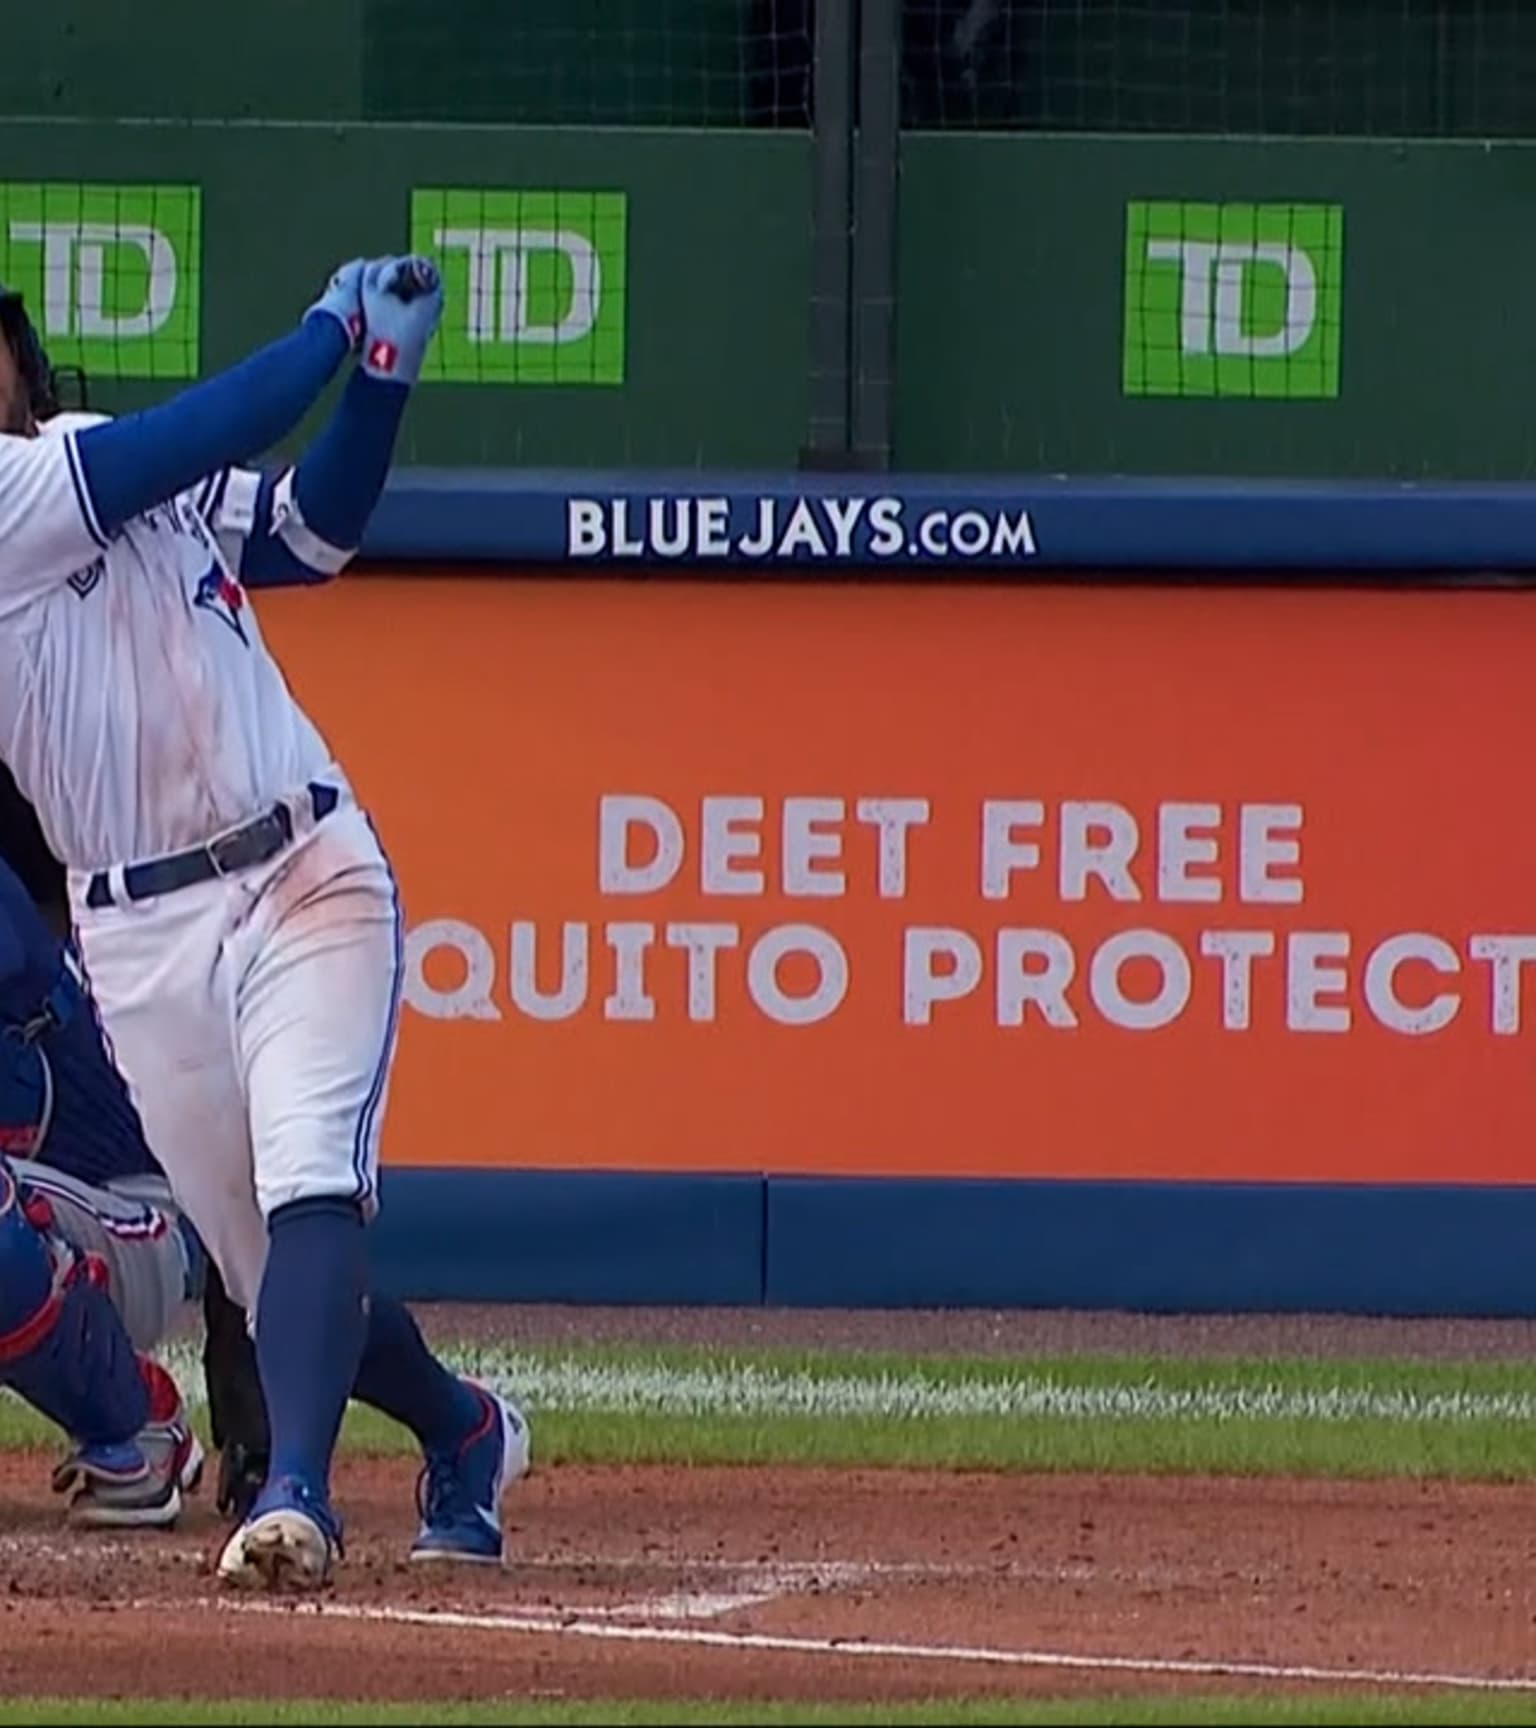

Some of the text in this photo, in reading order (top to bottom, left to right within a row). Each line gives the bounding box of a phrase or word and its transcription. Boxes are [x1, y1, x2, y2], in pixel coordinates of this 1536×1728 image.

[9, 221, 177, 338] TD
[433, 228, 602, 344] TD
[1147, 240, 1318, 357] TD
[599, 794, 1305, 904] DEET FREE
[403, 918, 1536, 1036] QUITO PROTECT
